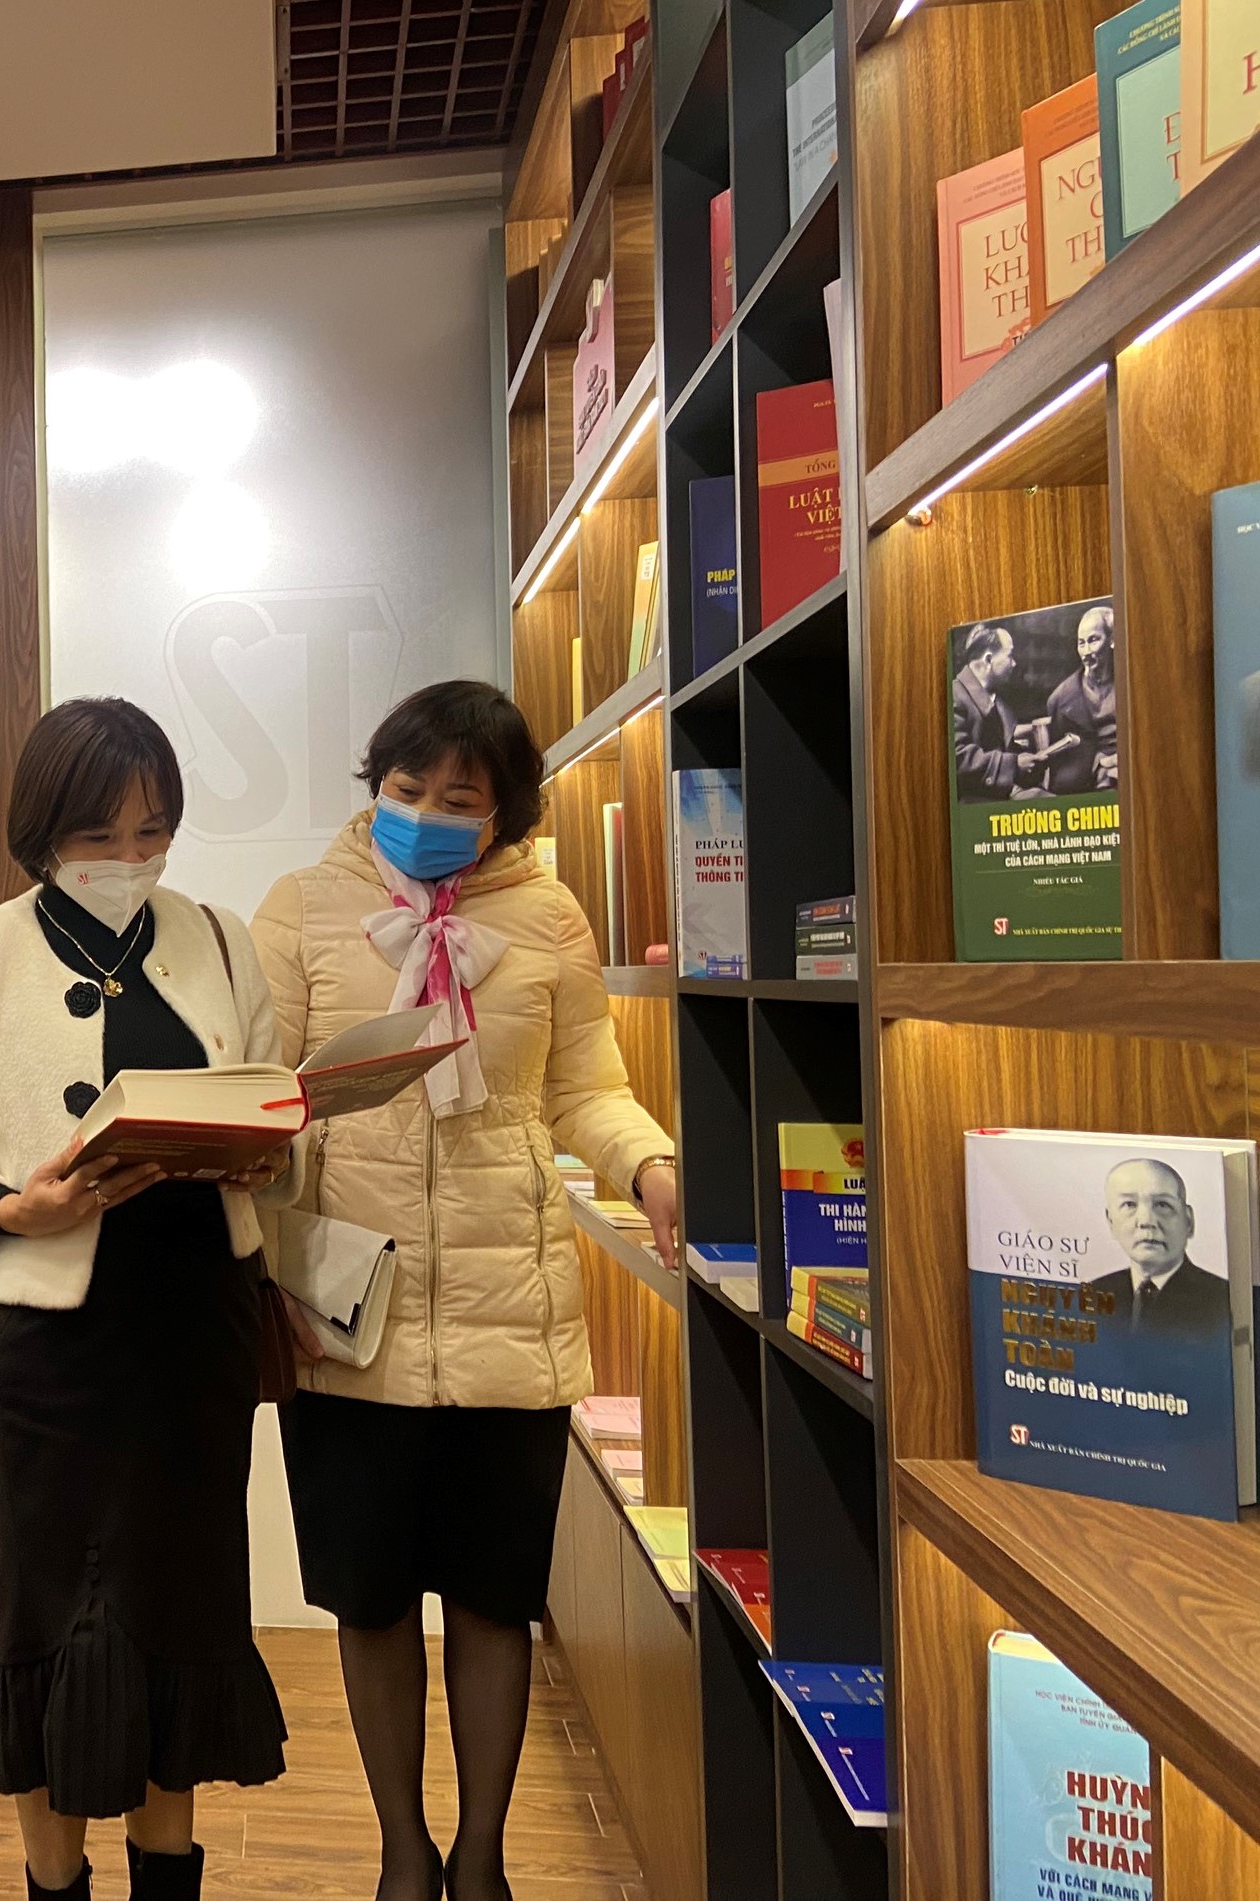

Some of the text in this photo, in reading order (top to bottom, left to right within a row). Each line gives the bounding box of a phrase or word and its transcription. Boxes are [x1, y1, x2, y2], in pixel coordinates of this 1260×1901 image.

[1057, 155, 1101, 201] NG
[789, 487, 833, 509] LUẬT
[707, 568, 735, 583] PHÁP
[169, 592, 395, 838] ST
[989, 808, 1062, 837] TRƯỜNG
[695, 838, 728, 849] PHÁP
[974, 841, 991, 856] MỘT
[992, 839, 1005, 853] TRÍ
[1006, 838, 1021, 854] TUỆ
[1041, 836, 1060, 850] NHÀ
[1005, 850, 1112, 867] CỦA CÁCH MẠNG VIỆT NAM
[695, 869, 731, 883] THÔNG
[994, 917, 1009, 935] ST
[818, 1203, 840, 1217] THI
[834, 1217, 867, 1232] HÌNH
[998, 1229, 1090, 1255] GIÁO SƯ
[1000, 1253, 1079, 1278] VIỆN SĨ
[1001, 1278, 1116, 1316] NGUYỄN
[1002, 1309, 1097, 1344] KHÁNH
[1002, 1339, 1075, 1373] TOÀN
[1004, 1369, 1189, 1416] Cuộc đời và sự nghiệp
[1010, 1424, 1029, 1445] ST
[1061, 1703, 1078, 1714] BAN
[1040, 1868, 1061, 1884] VỚI
[1065, 1873, 1097, 1894] CÁCH
[1037, 1884, 1055, 1900] VÀ
